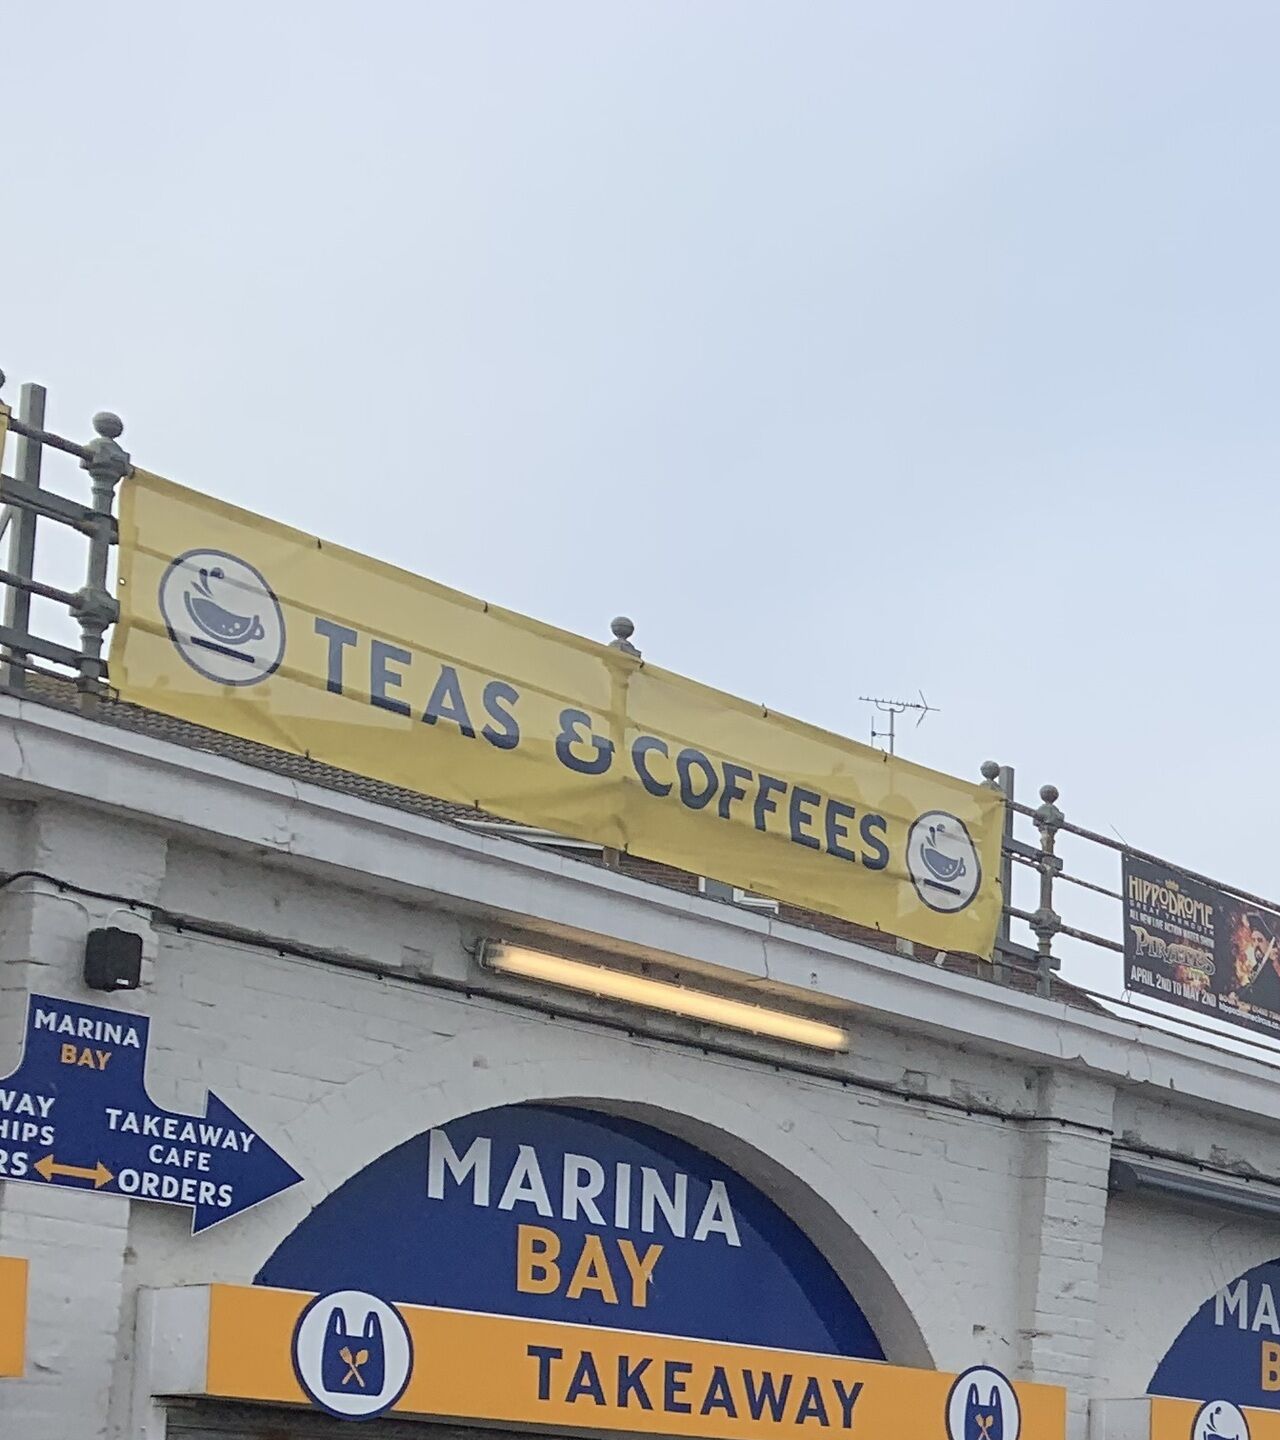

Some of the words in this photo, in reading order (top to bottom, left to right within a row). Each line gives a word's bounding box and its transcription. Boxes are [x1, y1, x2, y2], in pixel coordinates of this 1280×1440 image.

[314, 617, 521, 750] TEAS
[555, 708, 614, 775] &
[632, 734, 890, 870] COFFEES
[1129, 875, 1214, 929] HIPPODROME
[1131, 965, 1155, 987] APRIL
[1173, 981, 1182, 996] TO
[34, 1009, 140, 1048] MARINA
[60, 1043, 112, 1070] BAY
[0, 1088, 55, 1118] WAY
[0, 1121, 55, 1145] HIPS
[105, 1108, 254, 1152] TAKEAWAY
[150, 1144, 211, 1171] CAFE
[118, 1169, 233, 1208] ORDERS
[427, 1129, 741, 1247] MARINA
[516, 1224, 664, 1308] BAY
[527, 1344, 864, 1429] TAKEAWAY
